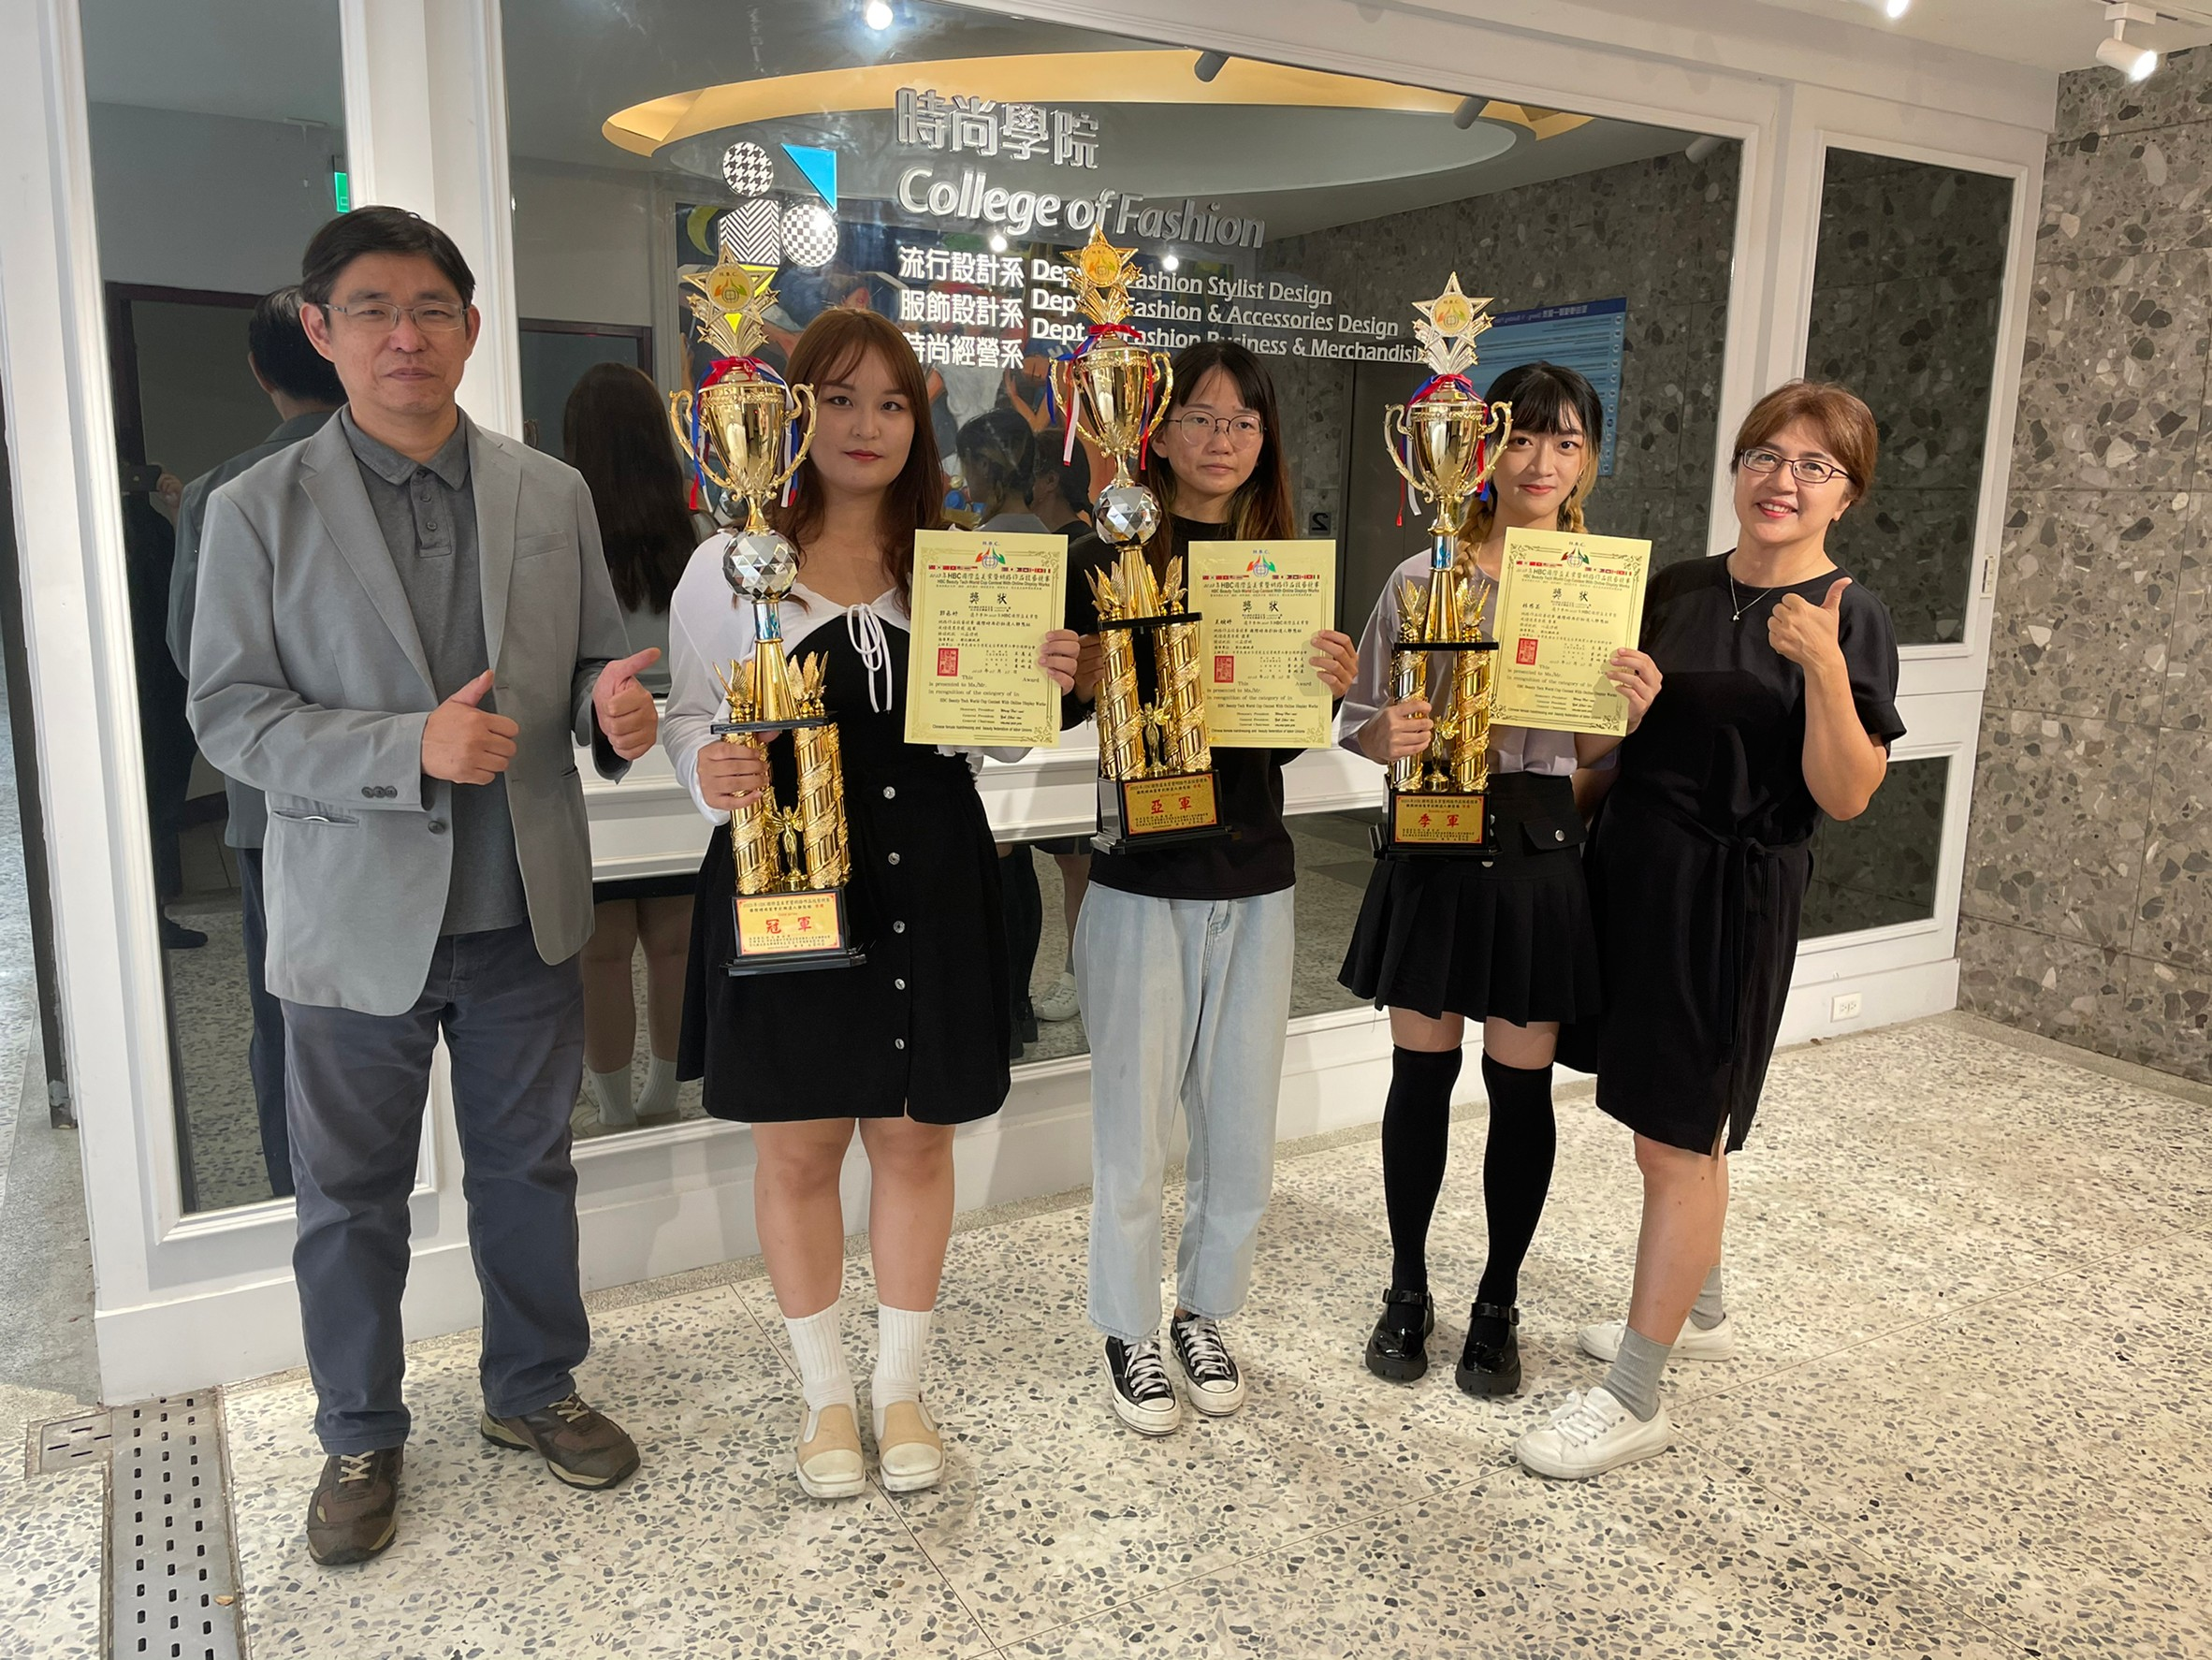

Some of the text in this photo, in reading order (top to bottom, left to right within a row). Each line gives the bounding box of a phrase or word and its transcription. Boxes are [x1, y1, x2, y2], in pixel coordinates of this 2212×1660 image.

[895, 87, 1099, 169] 時尚學院
[898, 166, 1266, 248] College of Fashion
[897, 246, 1025, 288] 流行設計系
[899, 288, 1025, 328] 服飾設計系
[1207, 275, 1264, 301] Stylist
[1269, 282, 1332, 308] Design
[1207, 303, 1222, 323] &
[1226, 304, 1333, 331] Accessories
[1338, 313, 1399, 340] Design
[1292, 337, 1305, 356] &
[1151, 796, 1192, 814] 亞軍
[1418, 813, 1460, 827] 季軍
[765, 916, 812, 934] 冠軍
